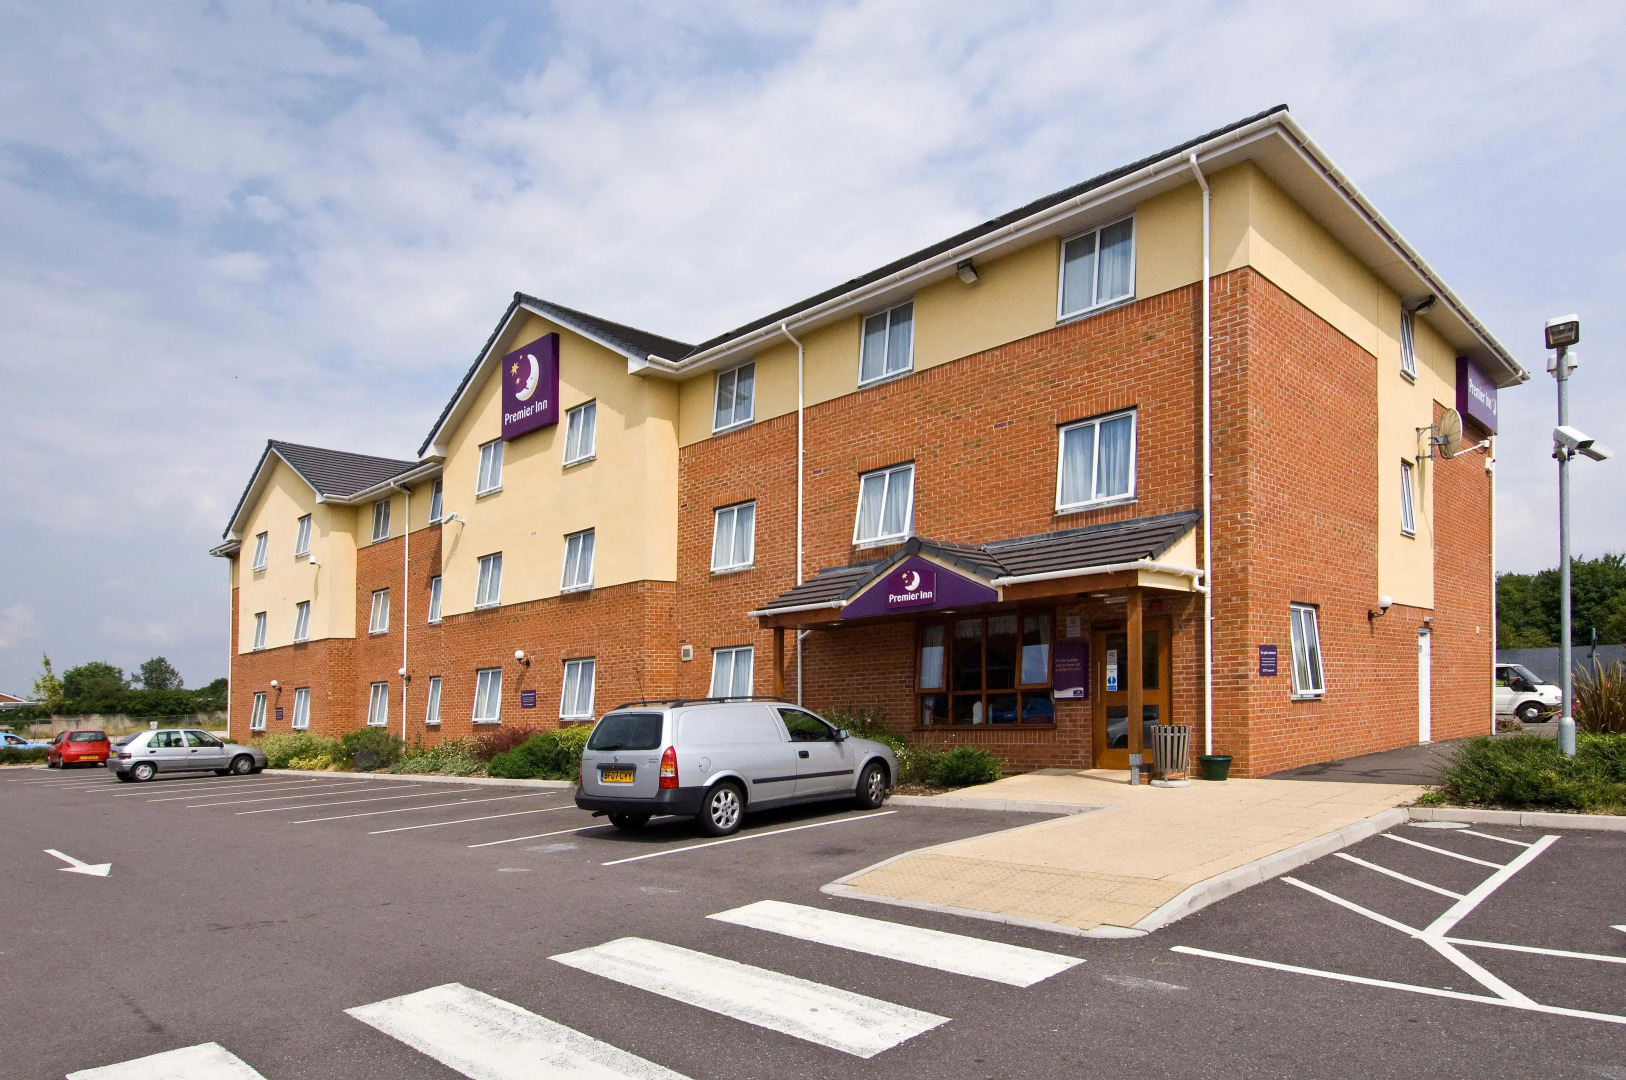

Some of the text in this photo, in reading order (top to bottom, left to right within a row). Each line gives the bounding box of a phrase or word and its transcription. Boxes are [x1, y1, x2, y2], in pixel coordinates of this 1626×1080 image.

[504, 399, 548, 425] Premier Inn
[889, 590, 933, 603] Premier Inn
